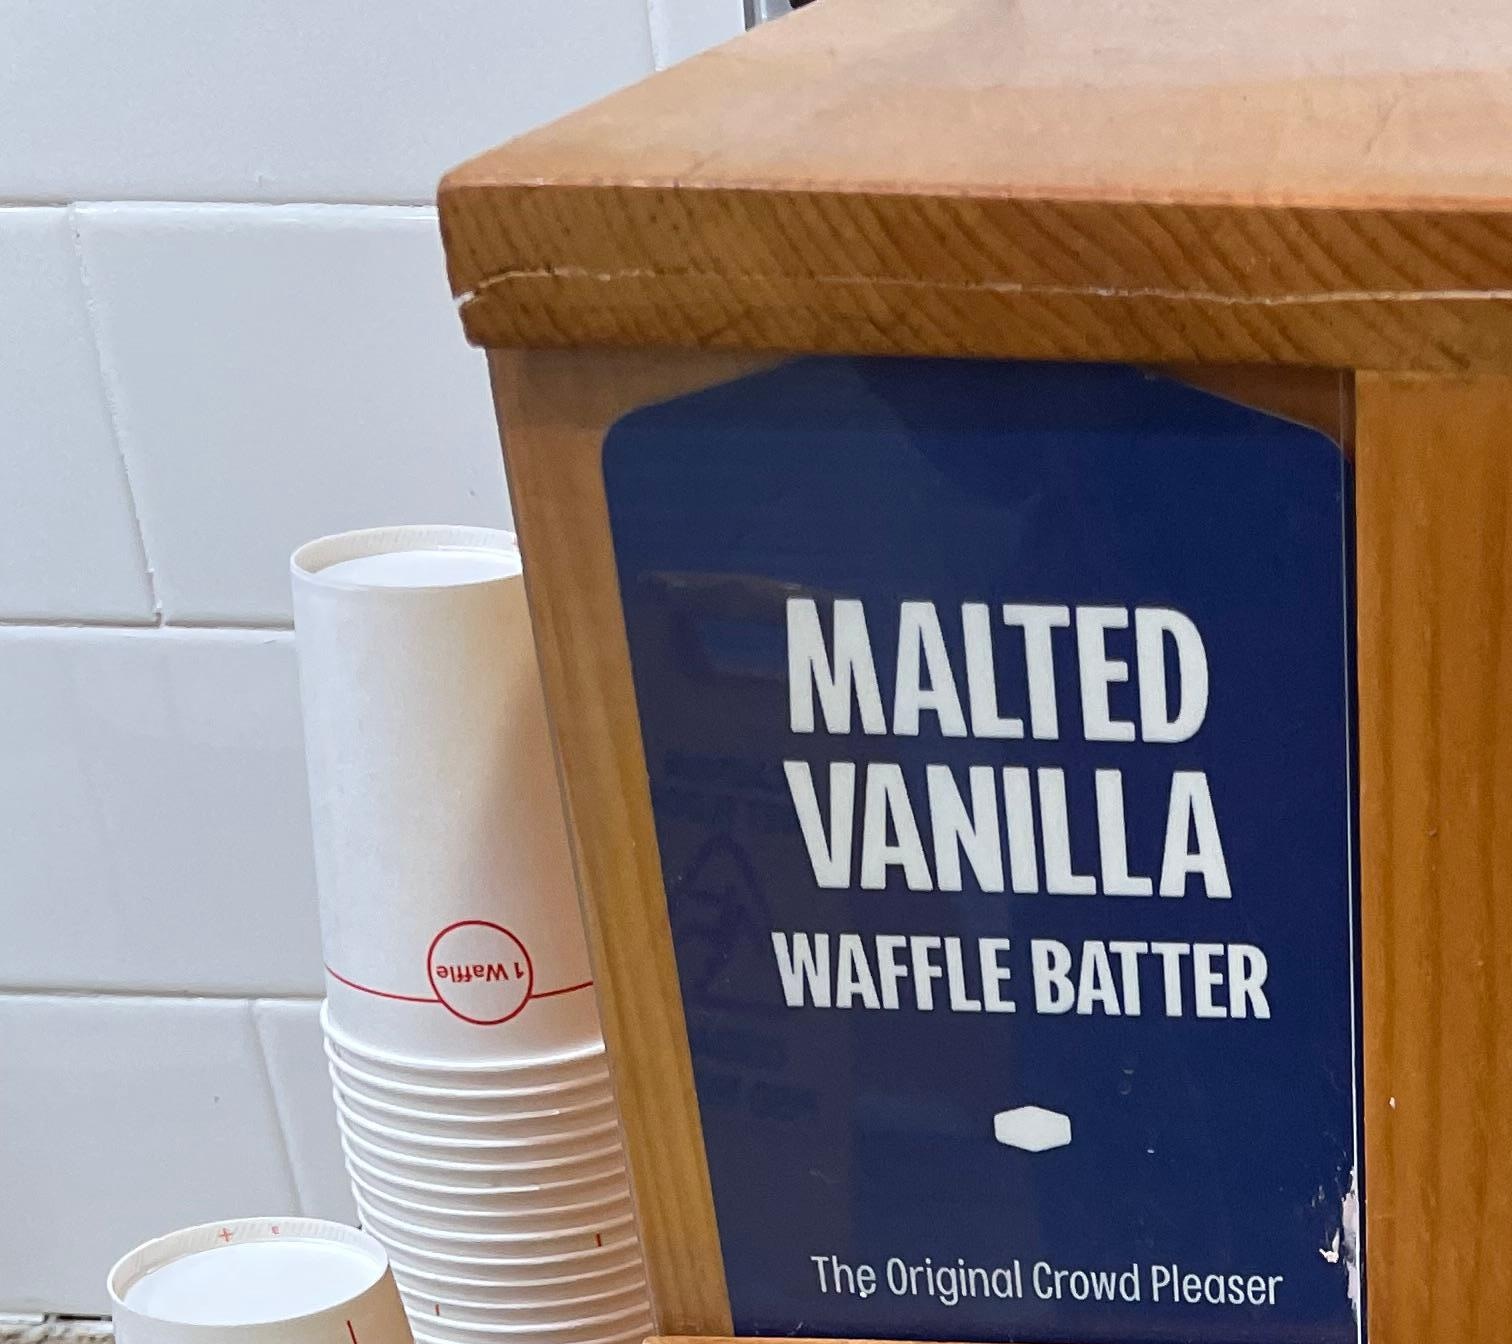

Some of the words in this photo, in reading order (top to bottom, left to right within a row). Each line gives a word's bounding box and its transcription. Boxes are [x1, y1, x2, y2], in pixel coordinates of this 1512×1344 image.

[786, 597, 1209, 743] MALTED
[783, 760, 1232, 899] VANILLA
[435, 963, 509, 983] Waffle
[513, 962, 525, 979] 1
[771, 931, 1016, 1013] WAFFLE
[1030, 938, 1271, 1019] BATTER
[810, 1255, 877, 1299] The
[886, 1257, 1023, 1306] Original
[1032, 1261, 1141, 1302] Crowd
[1151, 1263, 1284, 1305] Pleaser
